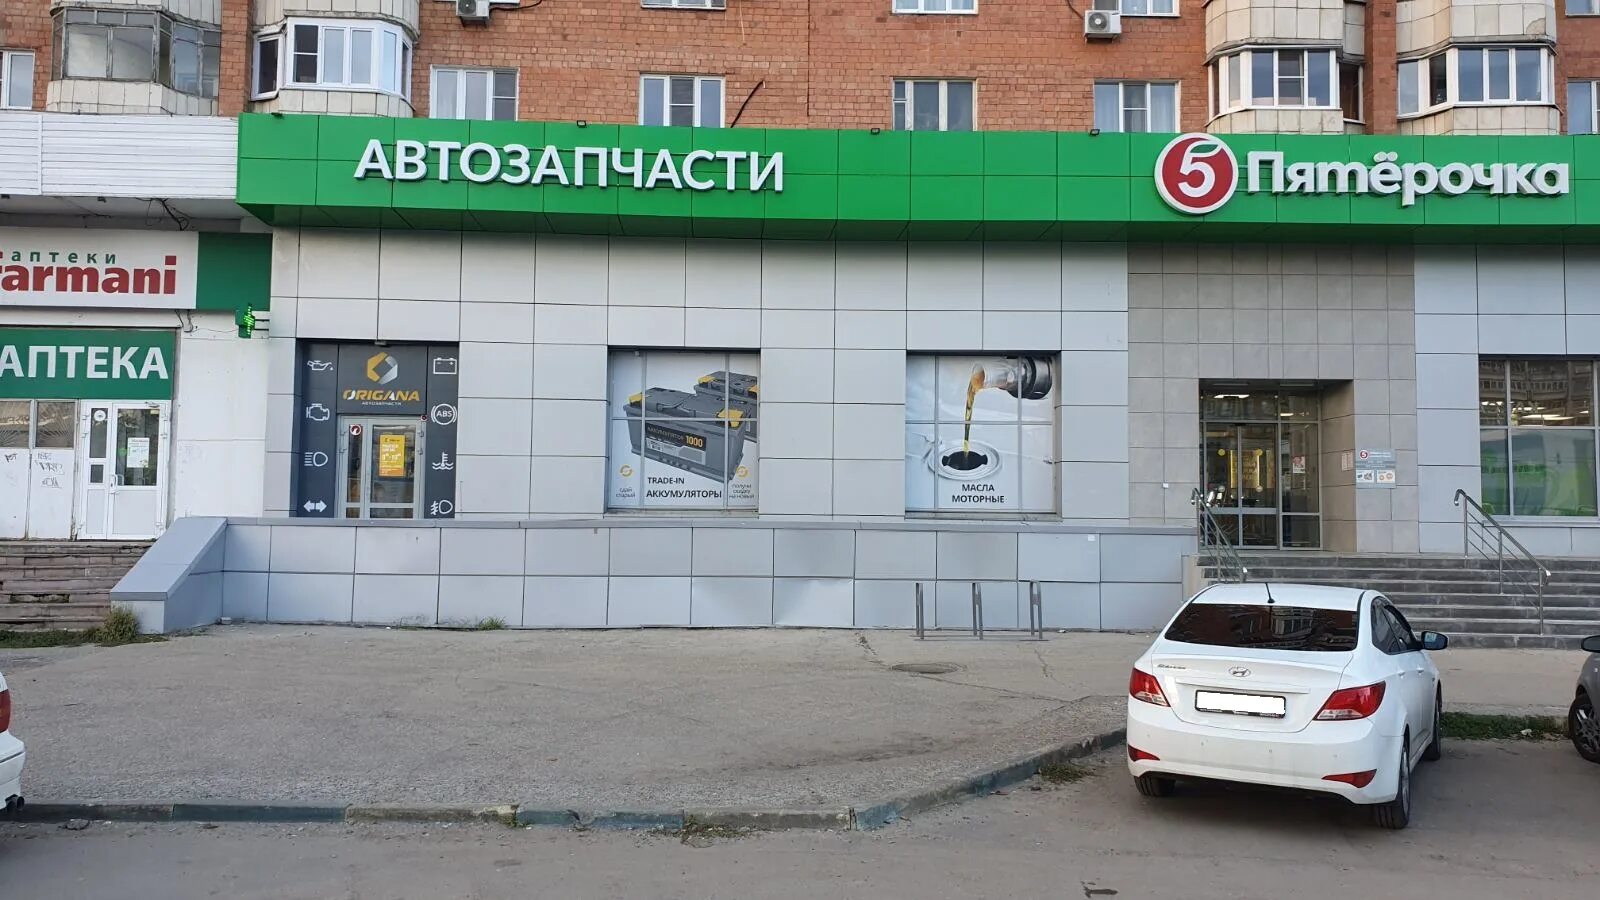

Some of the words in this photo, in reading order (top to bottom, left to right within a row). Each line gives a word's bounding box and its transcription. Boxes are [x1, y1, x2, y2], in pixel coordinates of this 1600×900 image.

[354, 139, 784, 193] АВТОЗАПЧАСТИ
[1247, 151, 1569, 206] Пятёрочка
[11, 250, 116, 265] аптеки
[0, 252, 177, 294] armani
[0, 345, 168, 379] АПТЕКА
[342, 389, 420, 401] ORIGANA
[436, 410, 453, 418] ABS
[686, 435, 703, 448] 1000
[648, 477, 685, 485] TRADE-IN
[646, 489, 722, 499] АККУМУЛЯТОРЫ
[962, 484, 994, 492] МАСЛА
[952, 495, 1005, 504] МОТОРНЫЕ
